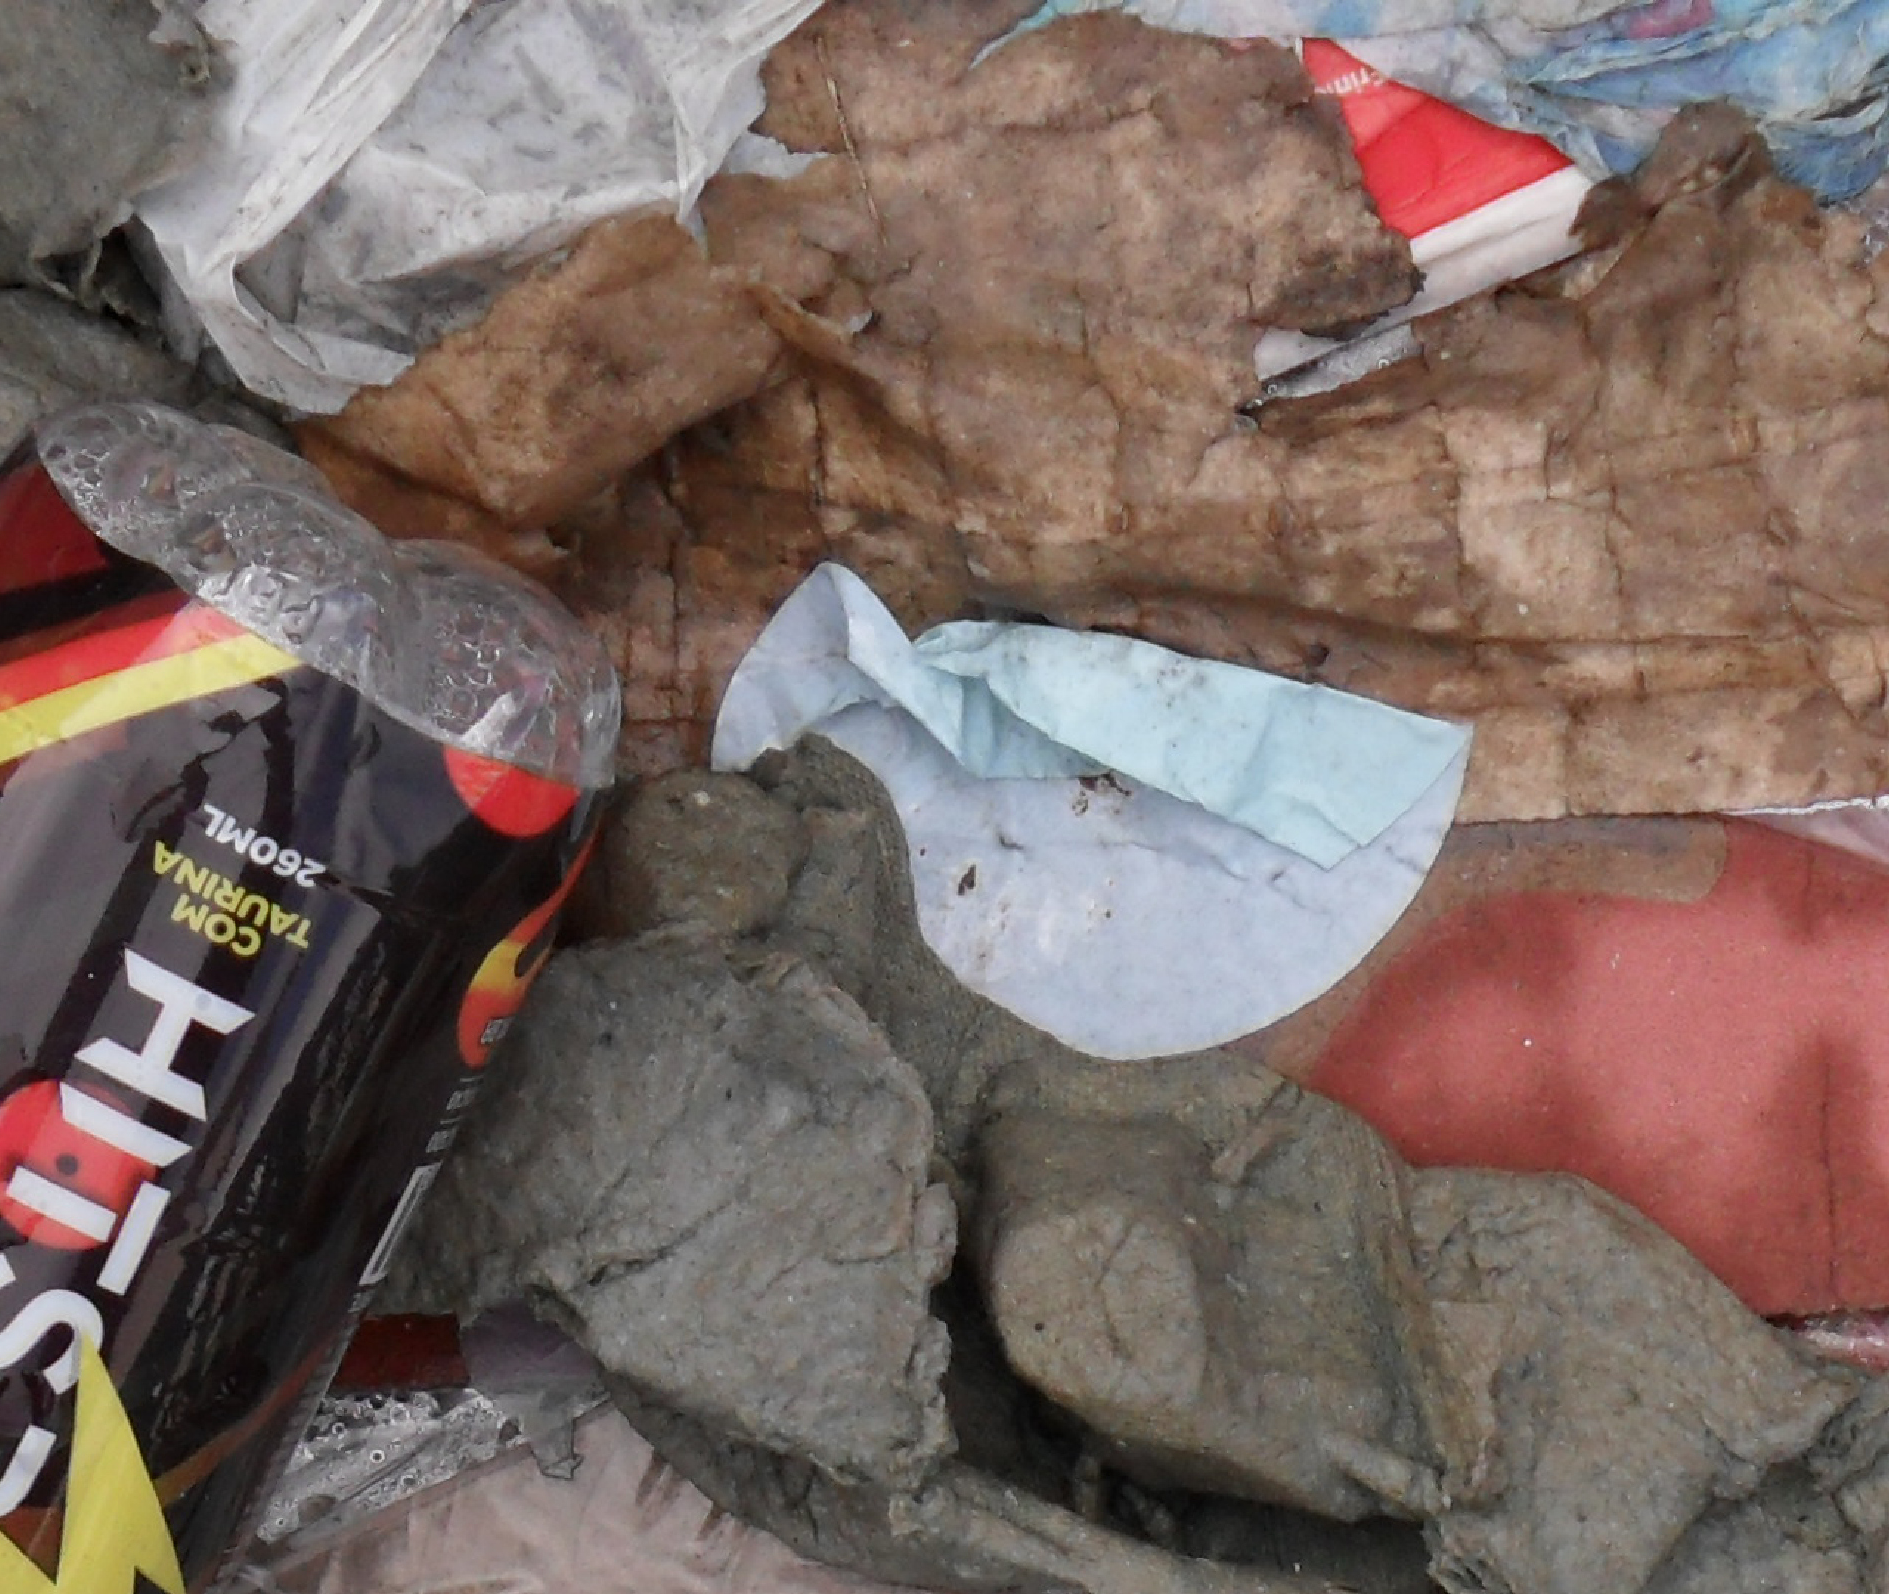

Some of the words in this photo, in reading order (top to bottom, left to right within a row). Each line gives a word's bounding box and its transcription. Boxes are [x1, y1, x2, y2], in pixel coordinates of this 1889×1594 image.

[203, 802, 329, 890] 260ML
[151, 840, 313, 951] TAURINA
[170, 893, 262, 959] COM
